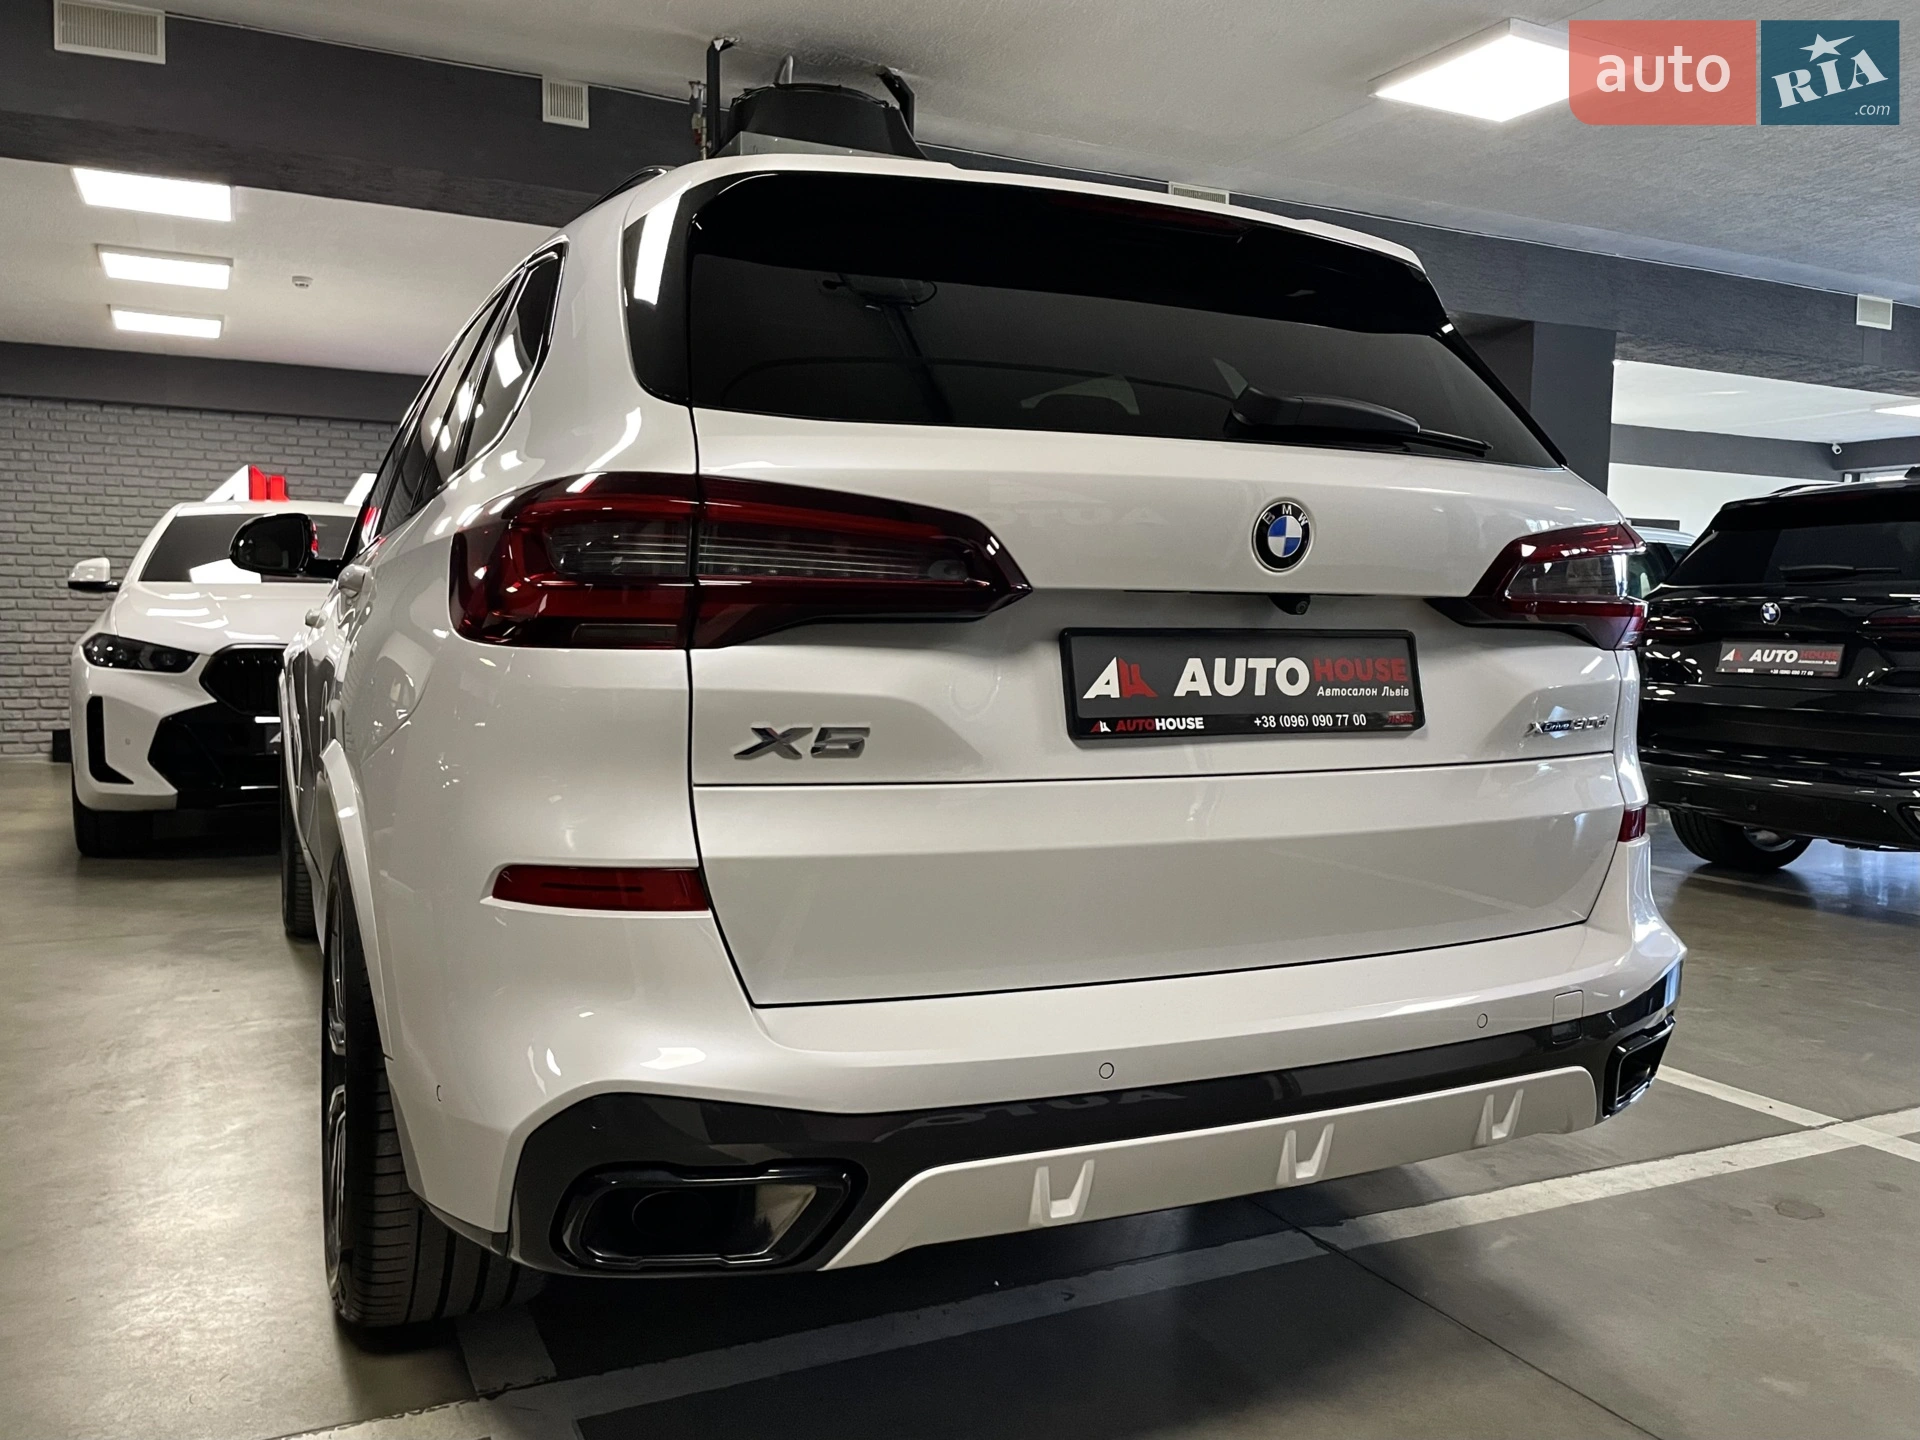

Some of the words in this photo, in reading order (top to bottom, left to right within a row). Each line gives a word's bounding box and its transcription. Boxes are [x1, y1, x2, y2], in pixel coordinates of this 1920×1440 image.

[1749, 649, 1798, 663] AUTO
[1173, 657, 1310, 696] AUTO
[1313, 656, 1408, 682] HOUSE
[1316, 686, 1378, 697] Автосалон
[1381, 685, 1410, 697] Львів
[1254, 715, 1277, 728] +38
[1279, 714, 1309, 728] (096)
[1312, 714, 1333, 727] 090
[1336, 714, 1350, 726] 77
[1353, 713, 1367, 726] 00
[733, 725, 871, 760] X5
